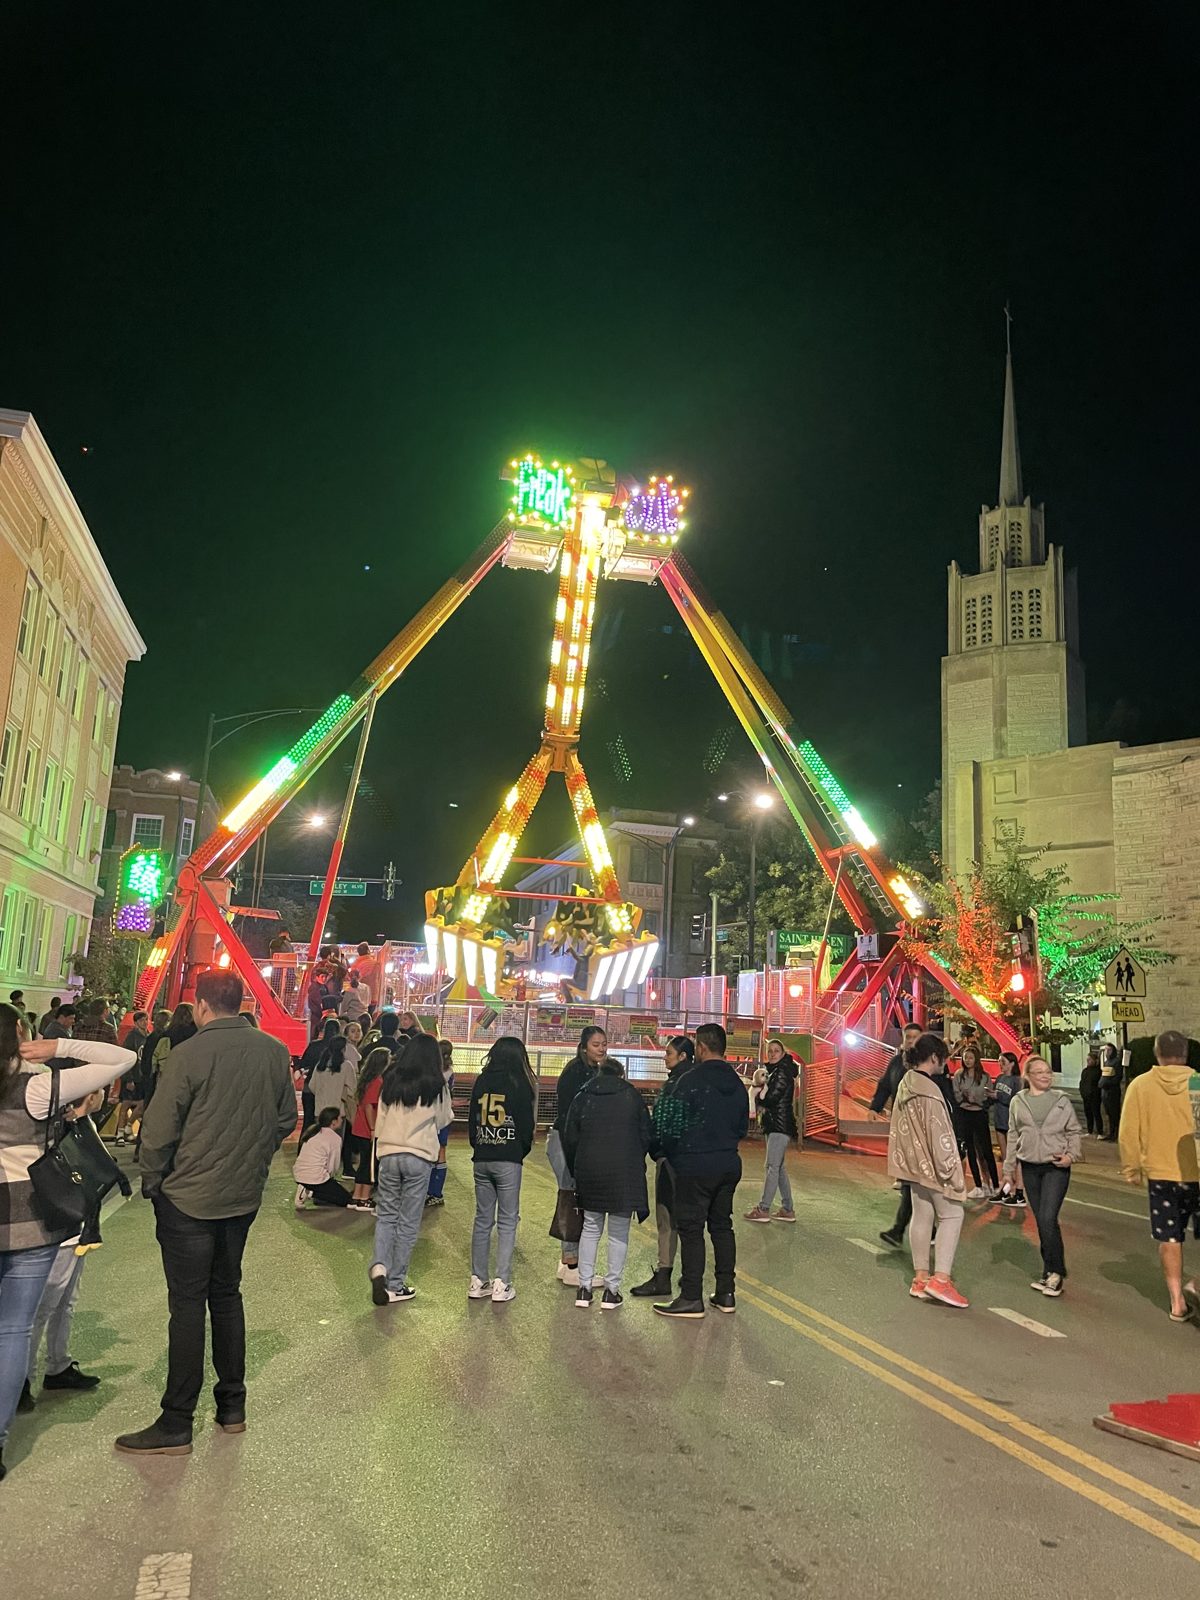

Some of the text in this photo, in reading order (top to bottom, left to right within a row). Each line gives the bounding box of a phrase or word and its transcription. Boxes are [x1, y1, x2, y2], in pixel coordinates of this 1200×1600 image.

[517, 461, 571, 523] Freak
[779, 932, 809, 943] SAINT
[1115, 1005, 1140, 1017] AHEAD
[478, 1093, 506, 1127] 15
